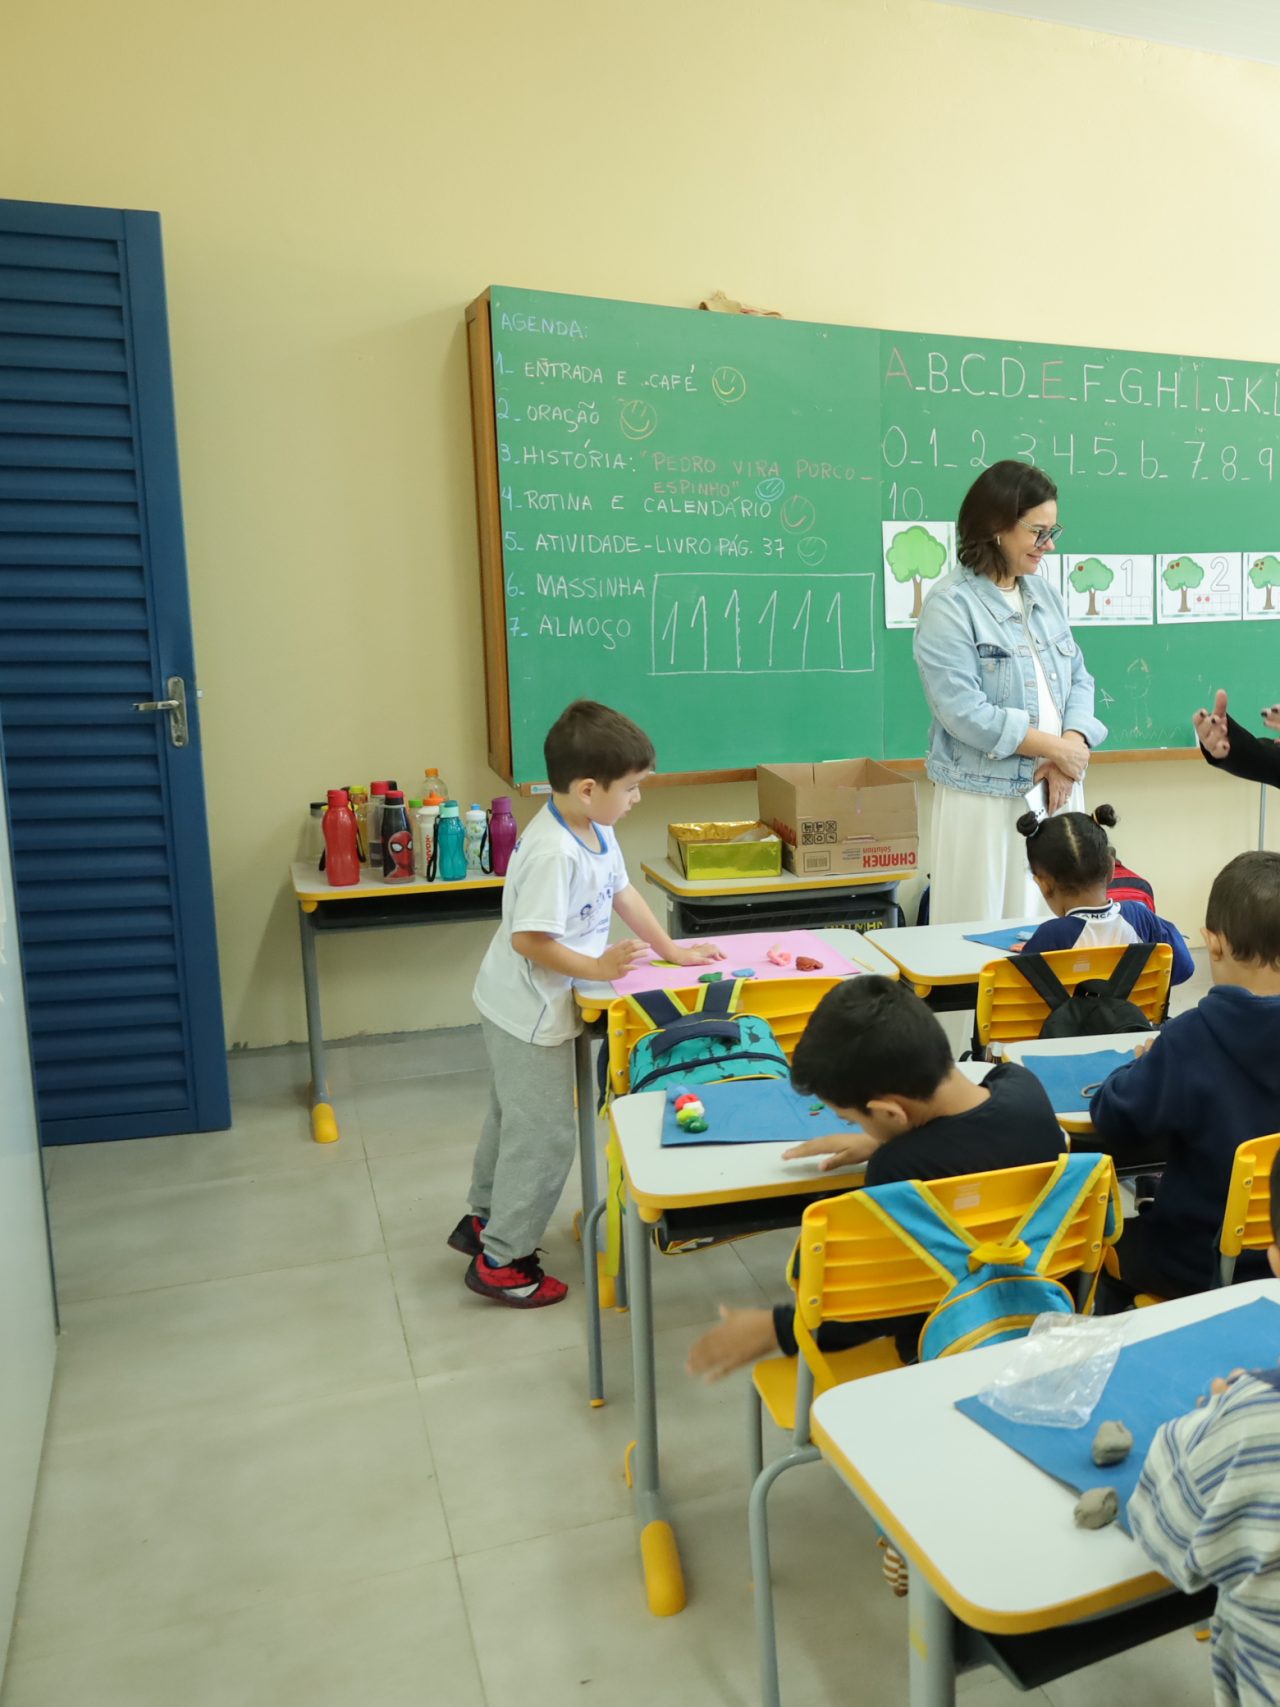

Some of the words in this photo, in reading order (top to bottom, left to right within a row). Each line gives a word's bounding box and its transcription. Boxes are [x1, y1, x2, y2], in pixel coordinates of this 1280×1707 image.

[617, 370, 627, 385] E
[649, 364, 697, 392] CAFÉ
[527, 401, 600, 432] ORAÇÃO
[733, 460, 780, 478] VIRA
[524, 490, 592, 511] ROTINA
[611, 495, 624, 510] E
[644, 496, 772, 518] CALENDÁRIO
[762, 537, 784, 559] 37
[537, 573, 645, 599] MASSINHA
[539, 614, 631, 649] ALMOÇO
